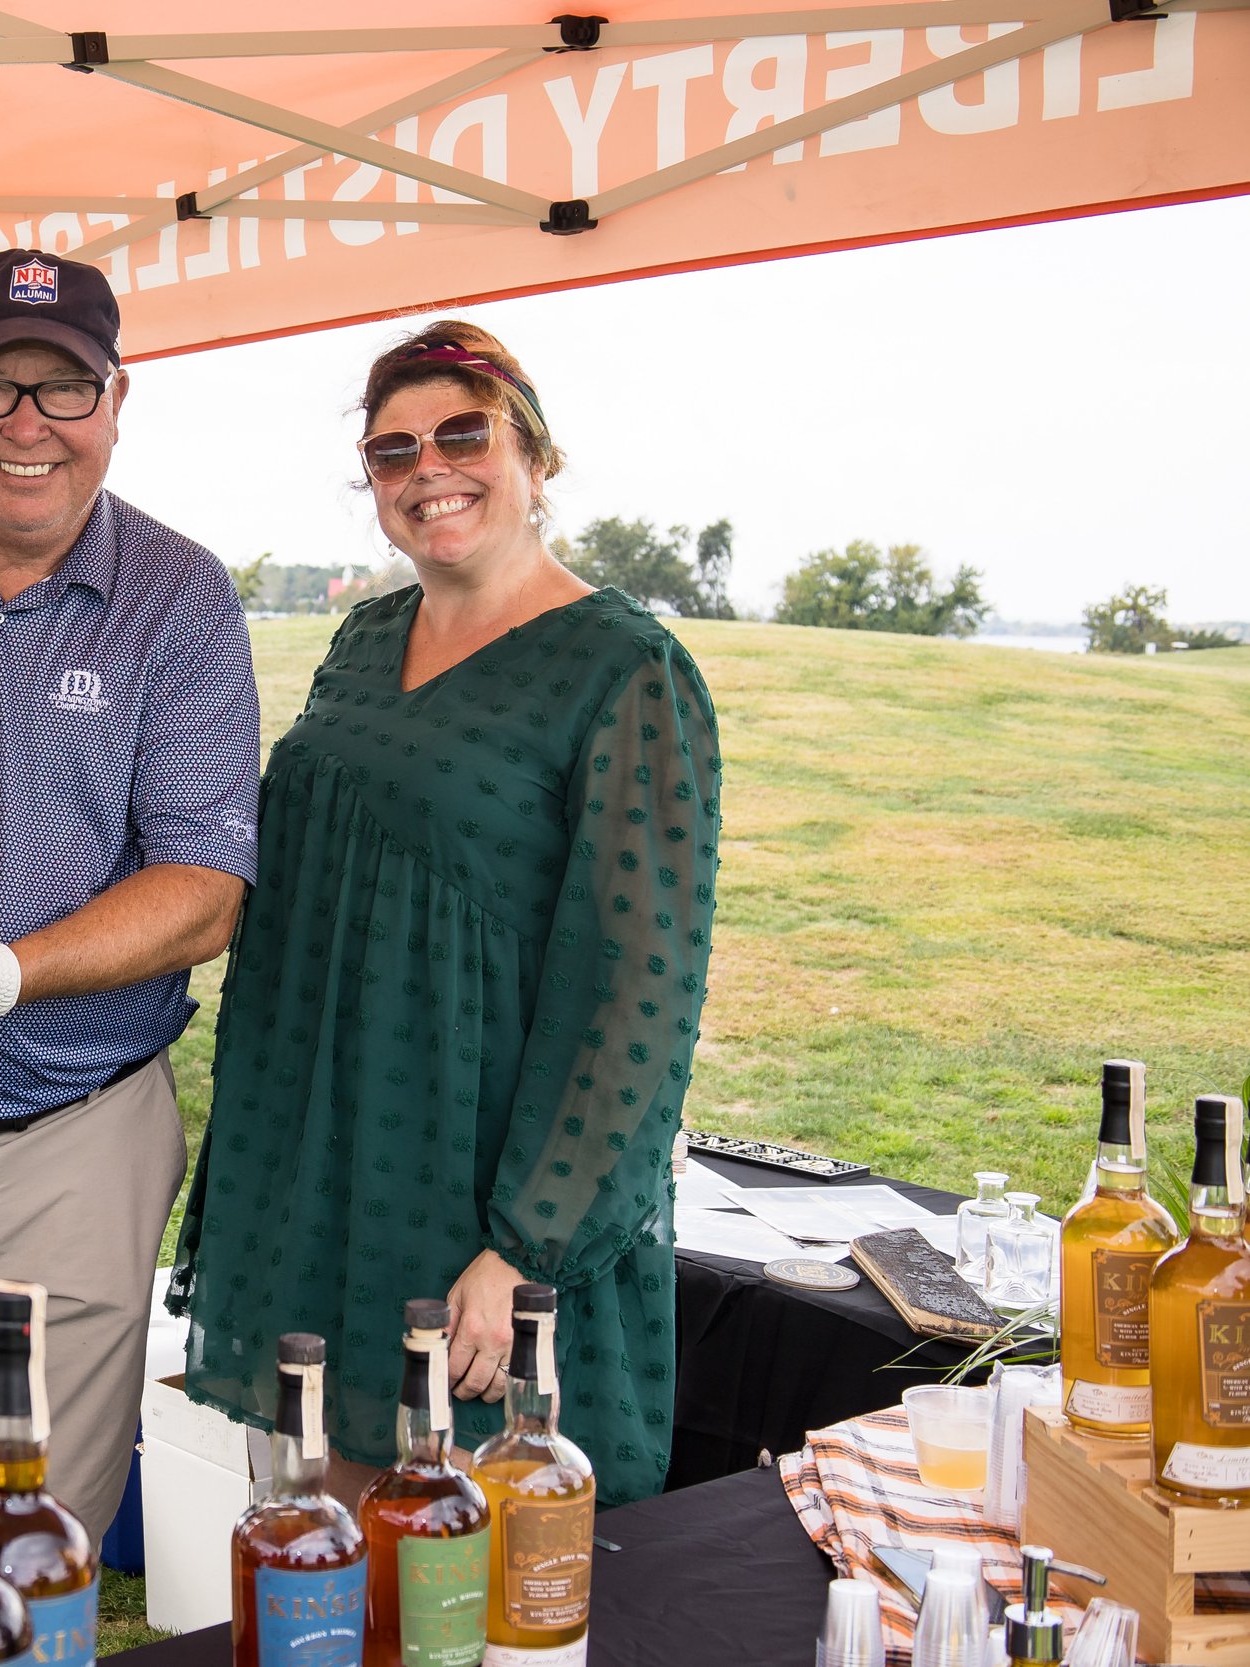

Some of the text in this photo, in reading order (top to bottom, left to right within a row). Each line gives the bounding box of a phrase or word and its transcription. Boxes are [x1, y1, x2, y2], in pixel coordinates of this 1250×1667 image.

[15, 267, 54, 286] NFL
[14, 289, 52, 301] ALUMNI
[267, 1588, 366, 1619] KINSE
